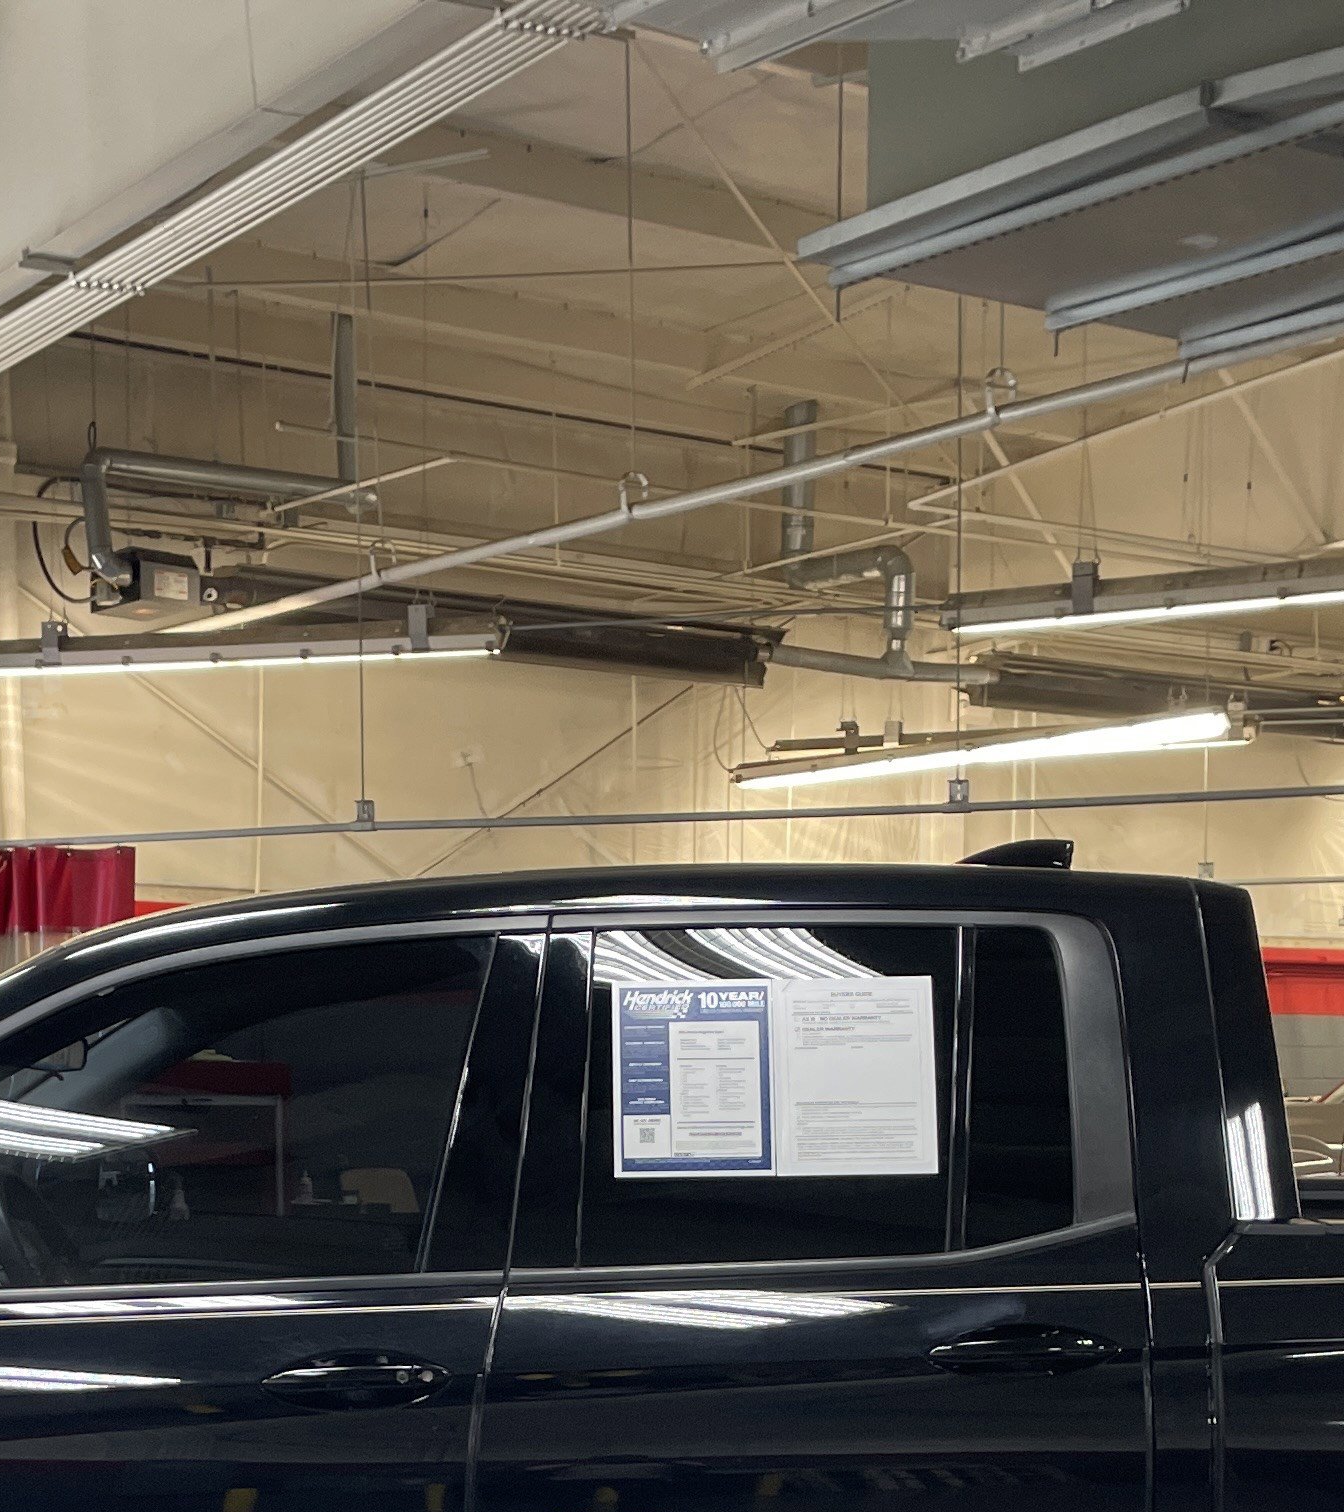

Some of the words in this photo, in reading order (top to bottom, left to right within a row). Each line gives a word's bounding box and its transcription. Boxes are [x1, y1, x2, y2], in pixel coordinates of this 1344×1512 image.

[623, 989, 694, 1011] Hendrick
[698, 992, 719, 1009] 10
[719, 991, 765, 1001] YEAR/
